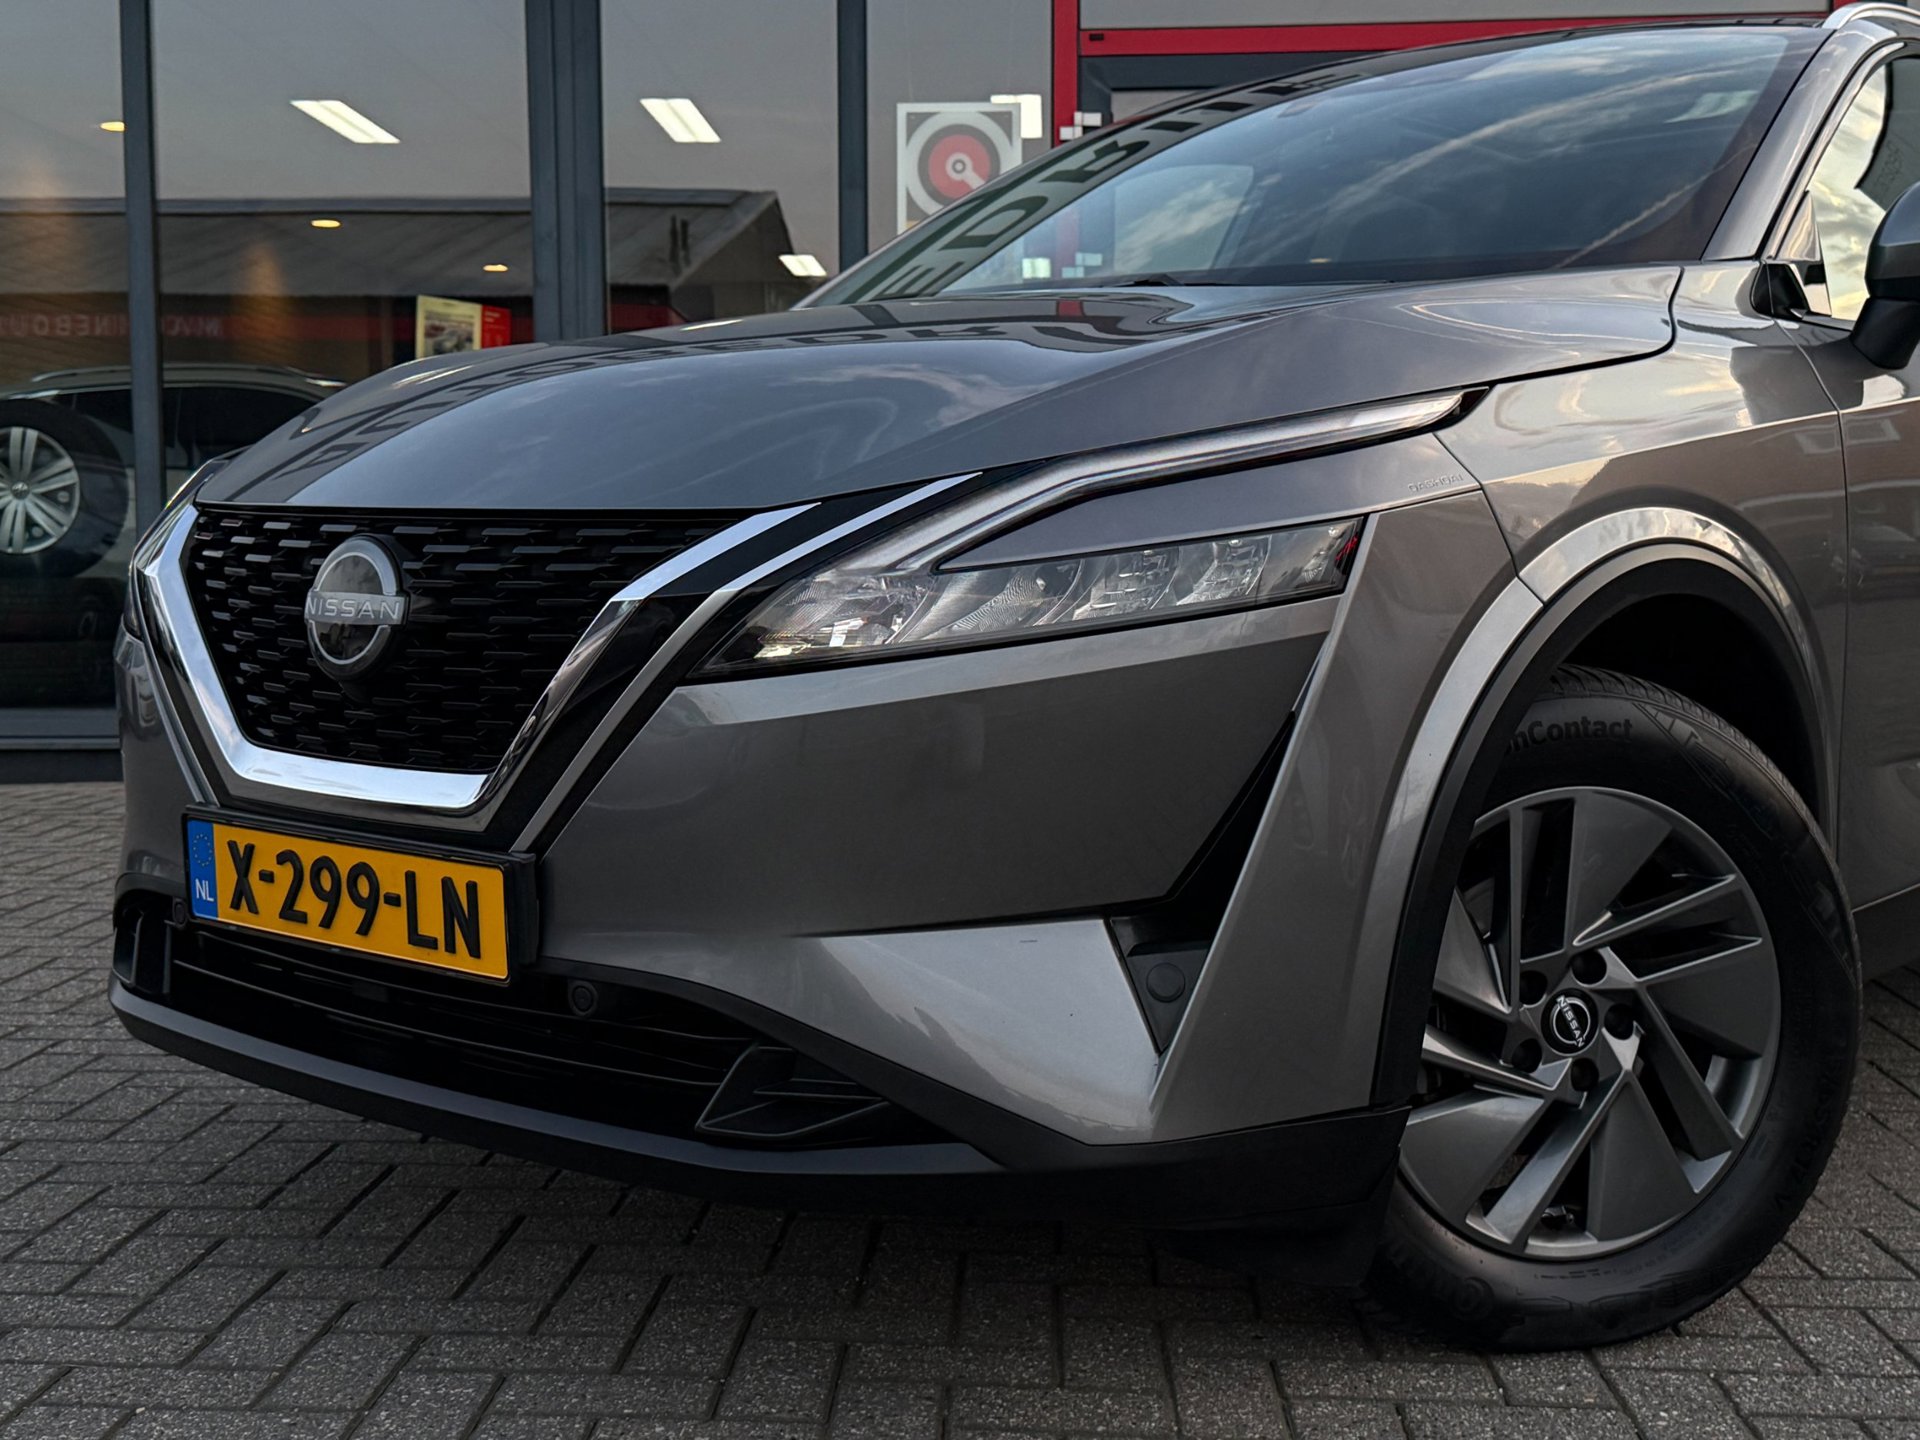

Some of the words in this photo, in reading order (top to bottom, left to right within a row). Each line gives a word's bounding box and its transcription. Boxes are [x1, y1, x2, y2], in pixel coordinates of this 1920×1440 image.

[1407, 474, 1464, 492] QASHQAI
[305, 596, 400, 620] NISSAN
[1502, 716, 1633, 753] nContact
[195, 878, 215, 902] NL
[227, 839, 482, 959] X-299-LN
[1556, 994, 1585, 1047] NISSAN
